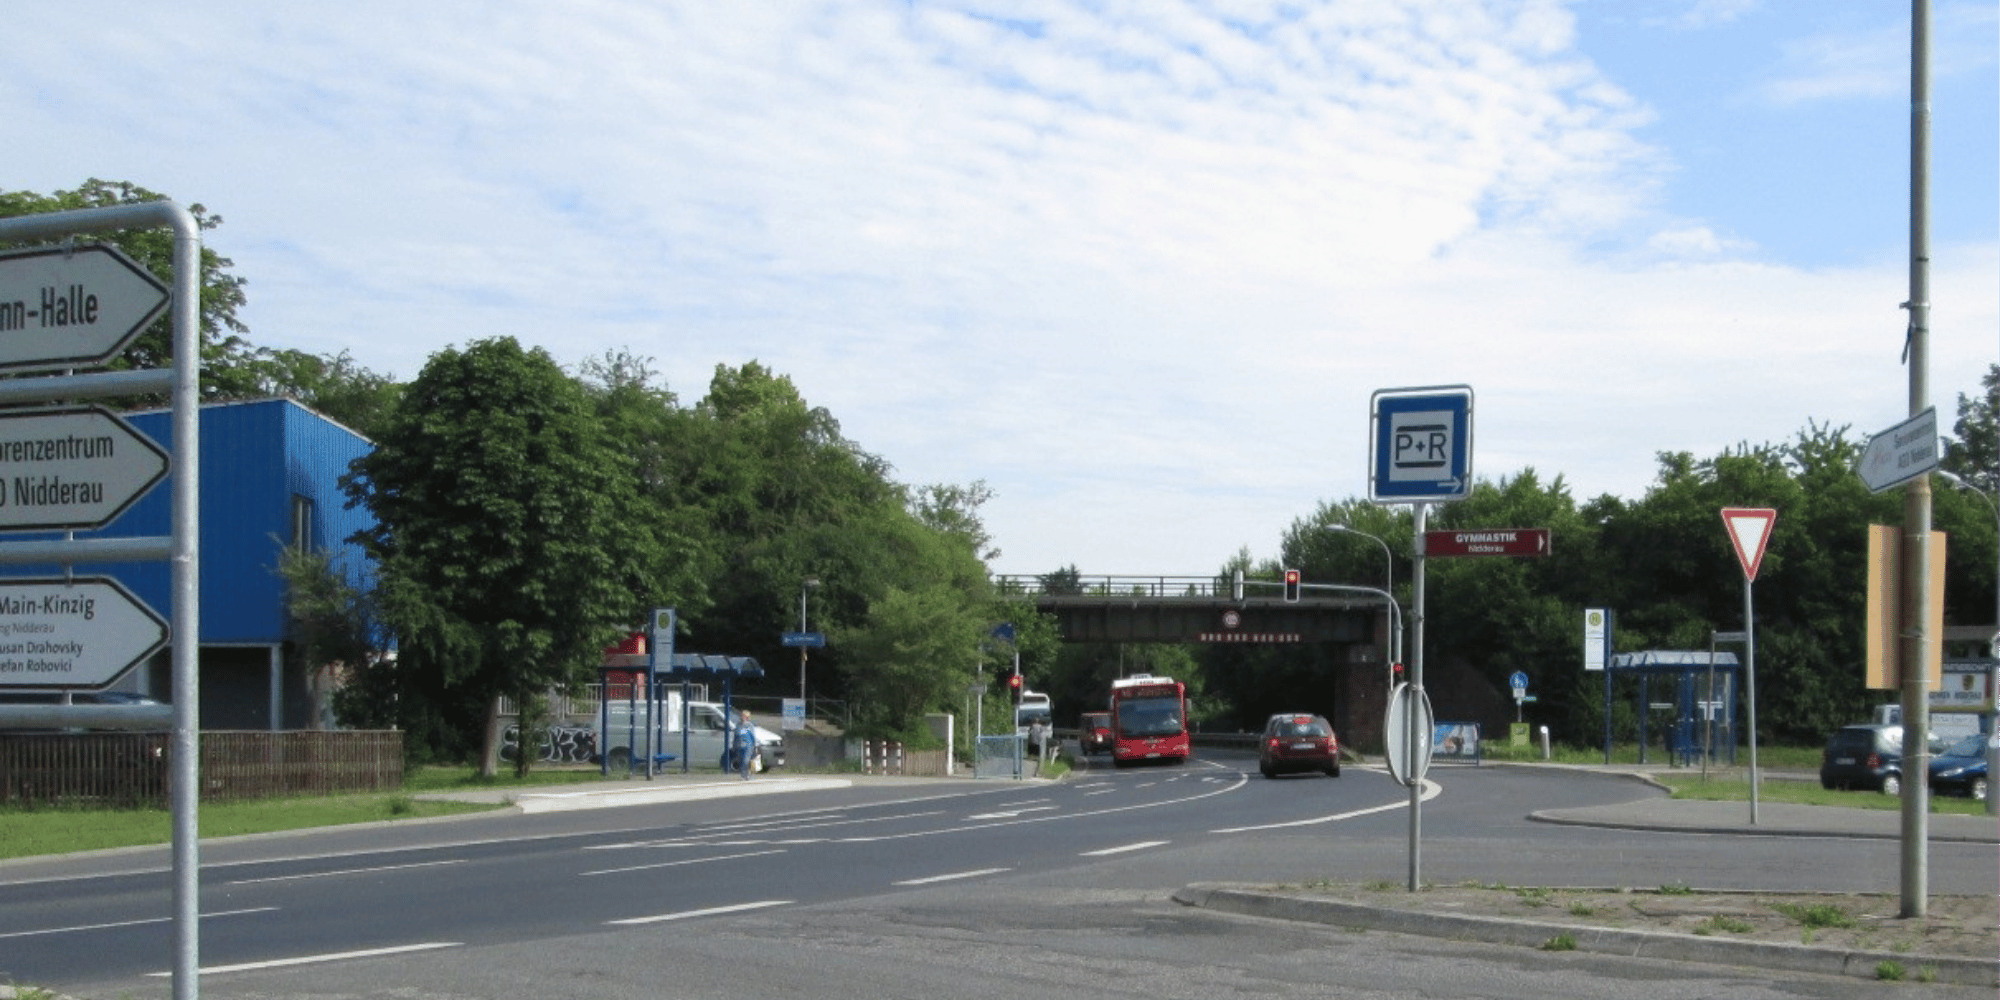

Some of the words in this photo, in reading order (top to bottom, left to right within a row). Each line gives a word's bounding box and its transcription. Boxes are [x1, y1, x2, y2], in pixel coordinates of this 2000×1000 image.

[0, 434, 114, 462] renzentrum
[1395, 432, 1447, 461] P+R
[14, 475, 103, 506] Nidderau
[1455, 532, 1517, 543] GYMNASTIK
[0, 594, 94, 620] Main-Kinzig
[12, 622, 55, 633] Nidderau
[27, 640, 83, 657] Drahovsky
[27, 658, 72, 672] Robovici
